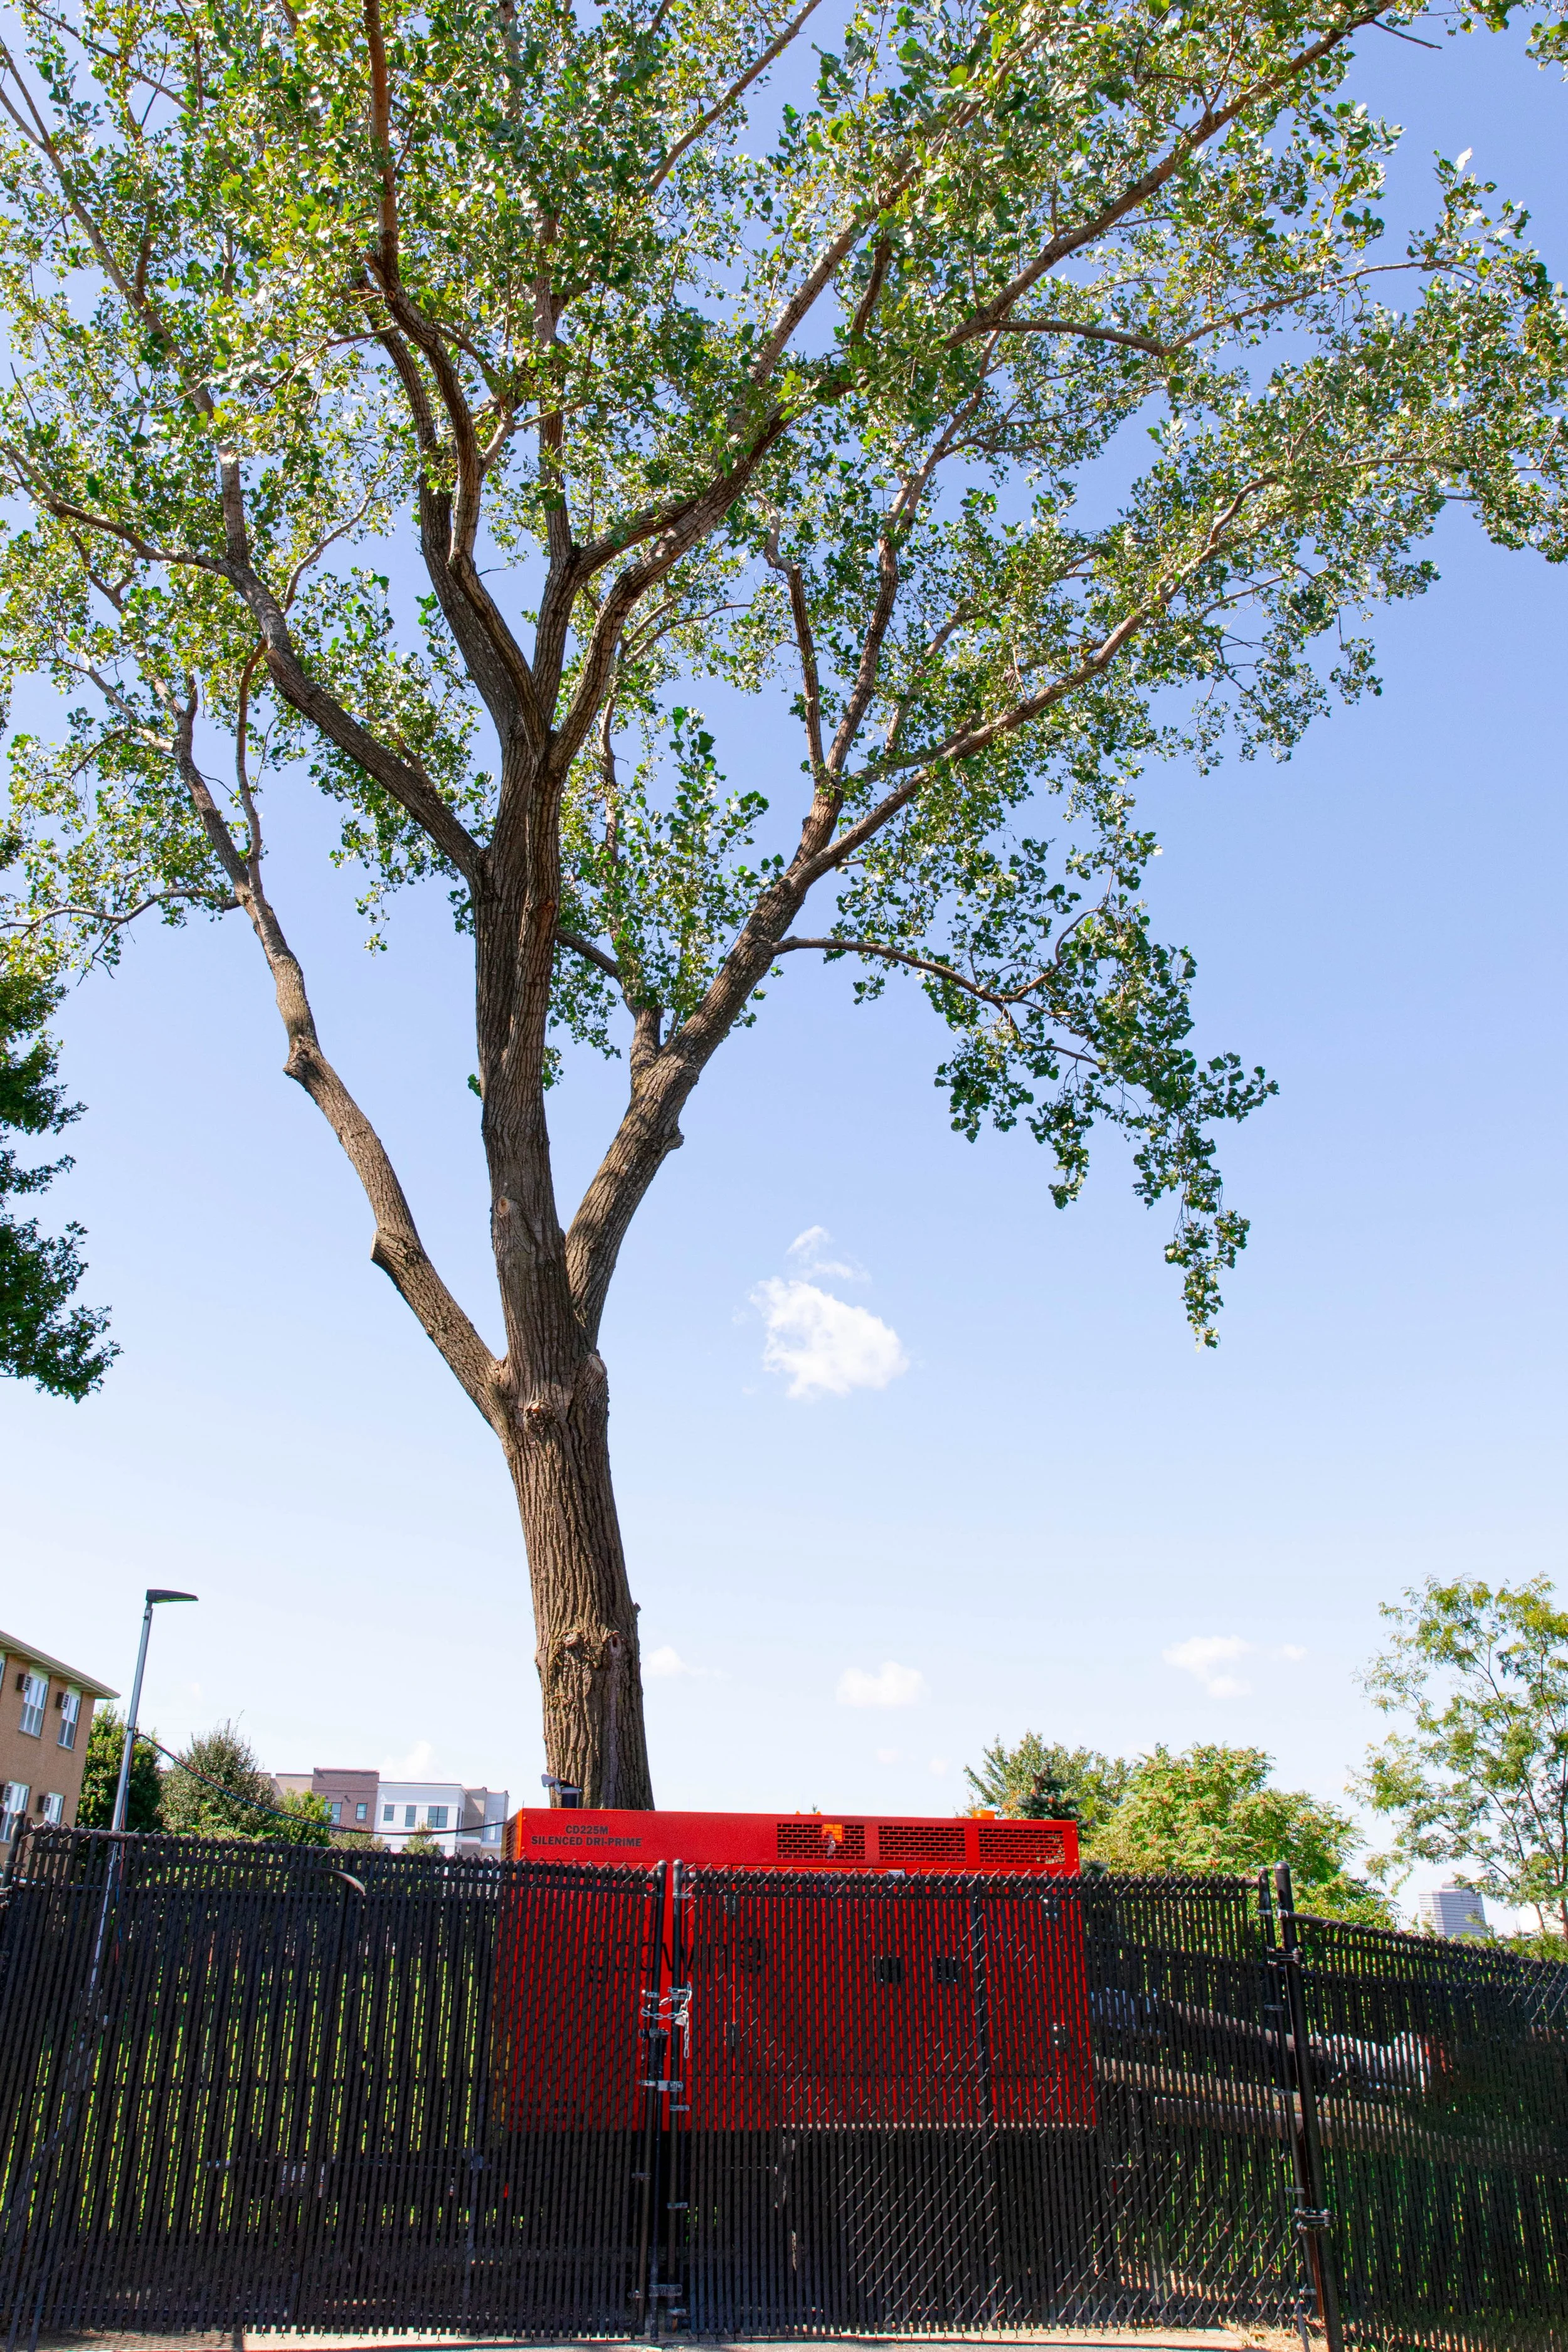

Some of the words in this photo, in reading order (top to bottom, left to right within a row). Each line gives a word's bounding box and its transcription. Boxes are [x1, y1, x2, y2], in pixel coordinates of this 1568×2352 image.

[566, 1825, 608, 1835] CD225M
[531, 1836, 583, 1846] SILENCED
[586, 1837, 642, 1847] DRI-PRIME
